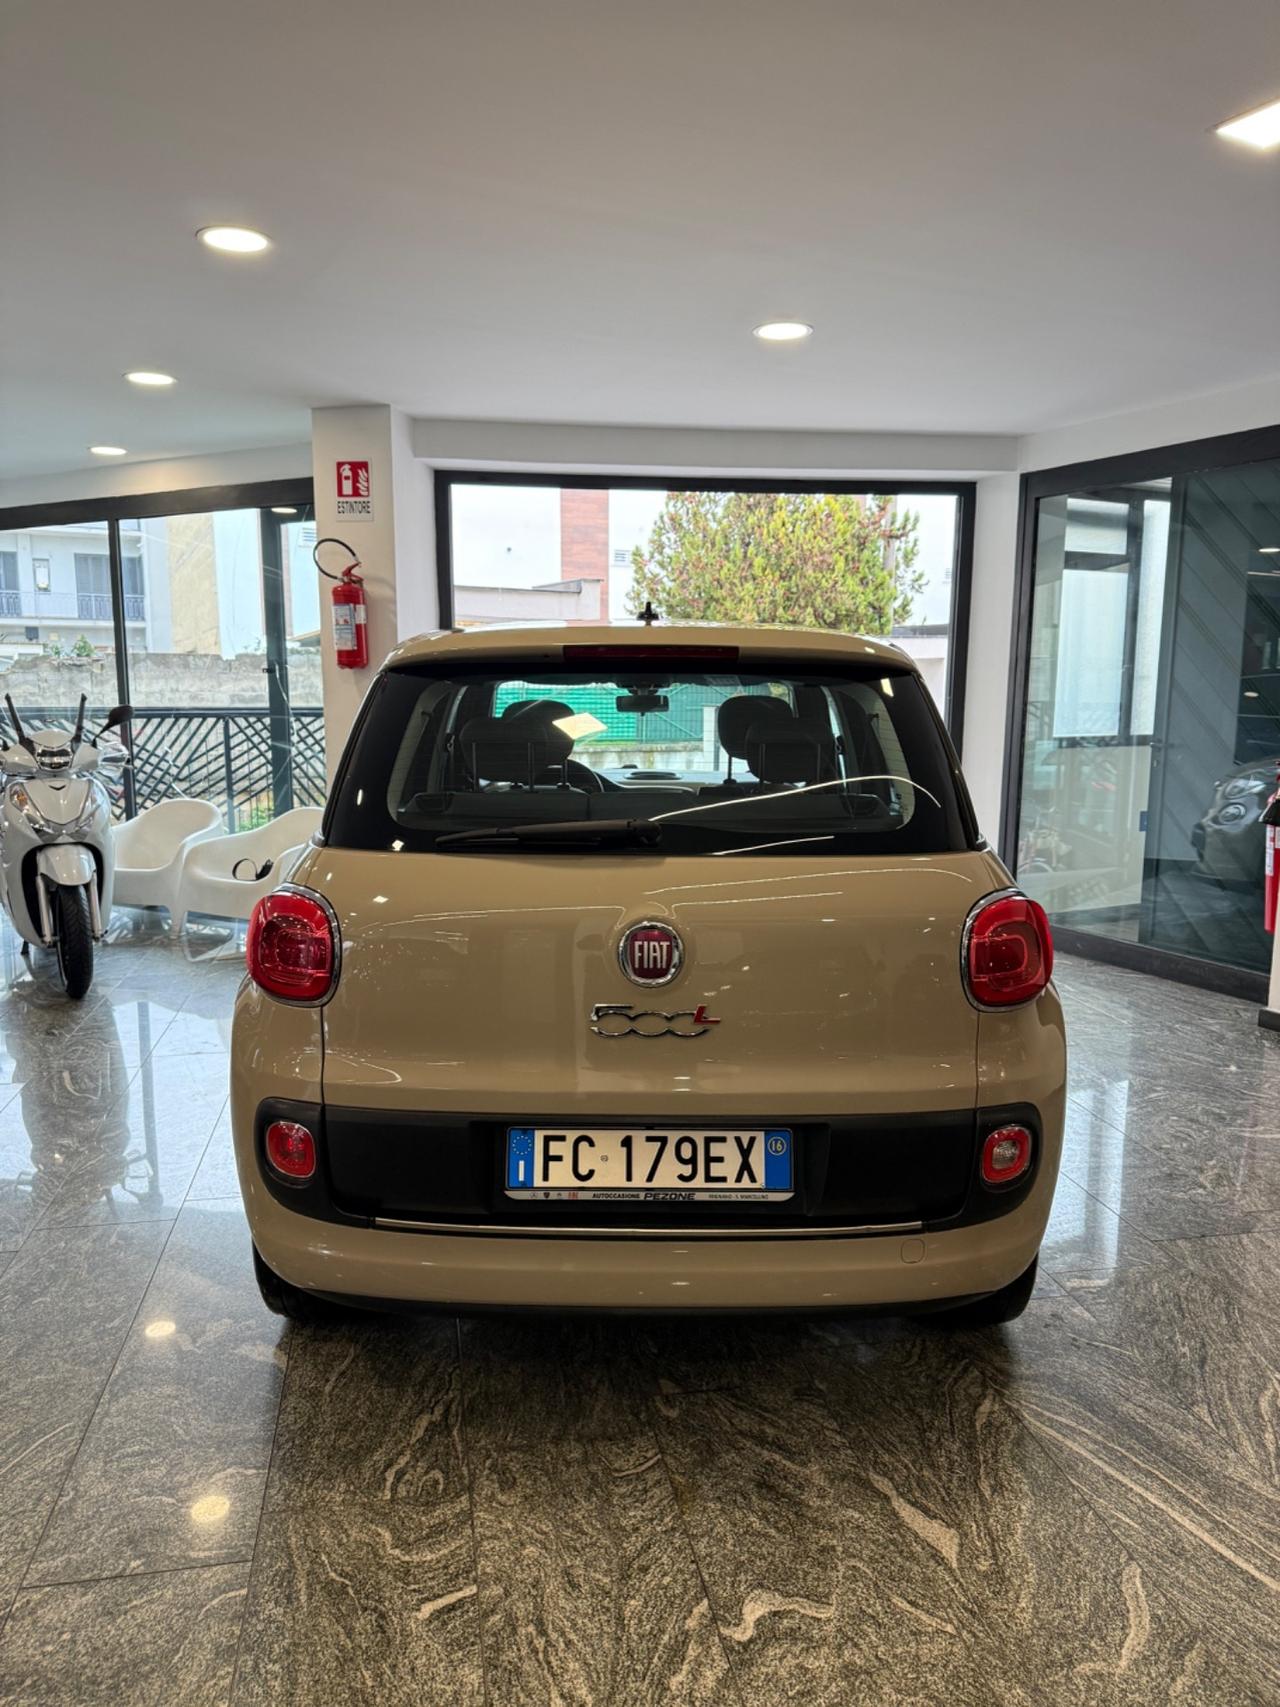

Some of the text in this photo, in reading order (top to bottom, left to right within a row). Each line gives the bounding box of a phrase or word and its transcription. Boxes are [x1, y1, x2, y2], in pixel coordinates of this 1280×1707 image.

[337, 501, 371, 514] ESTINTORE
[634, 941, 671, 969] FIAT
[771, 1140, 783, 1152] 16
[542, 1134, 758, 1184] FC 179EX
[643, 1192, 696, 1201] PEZONE
